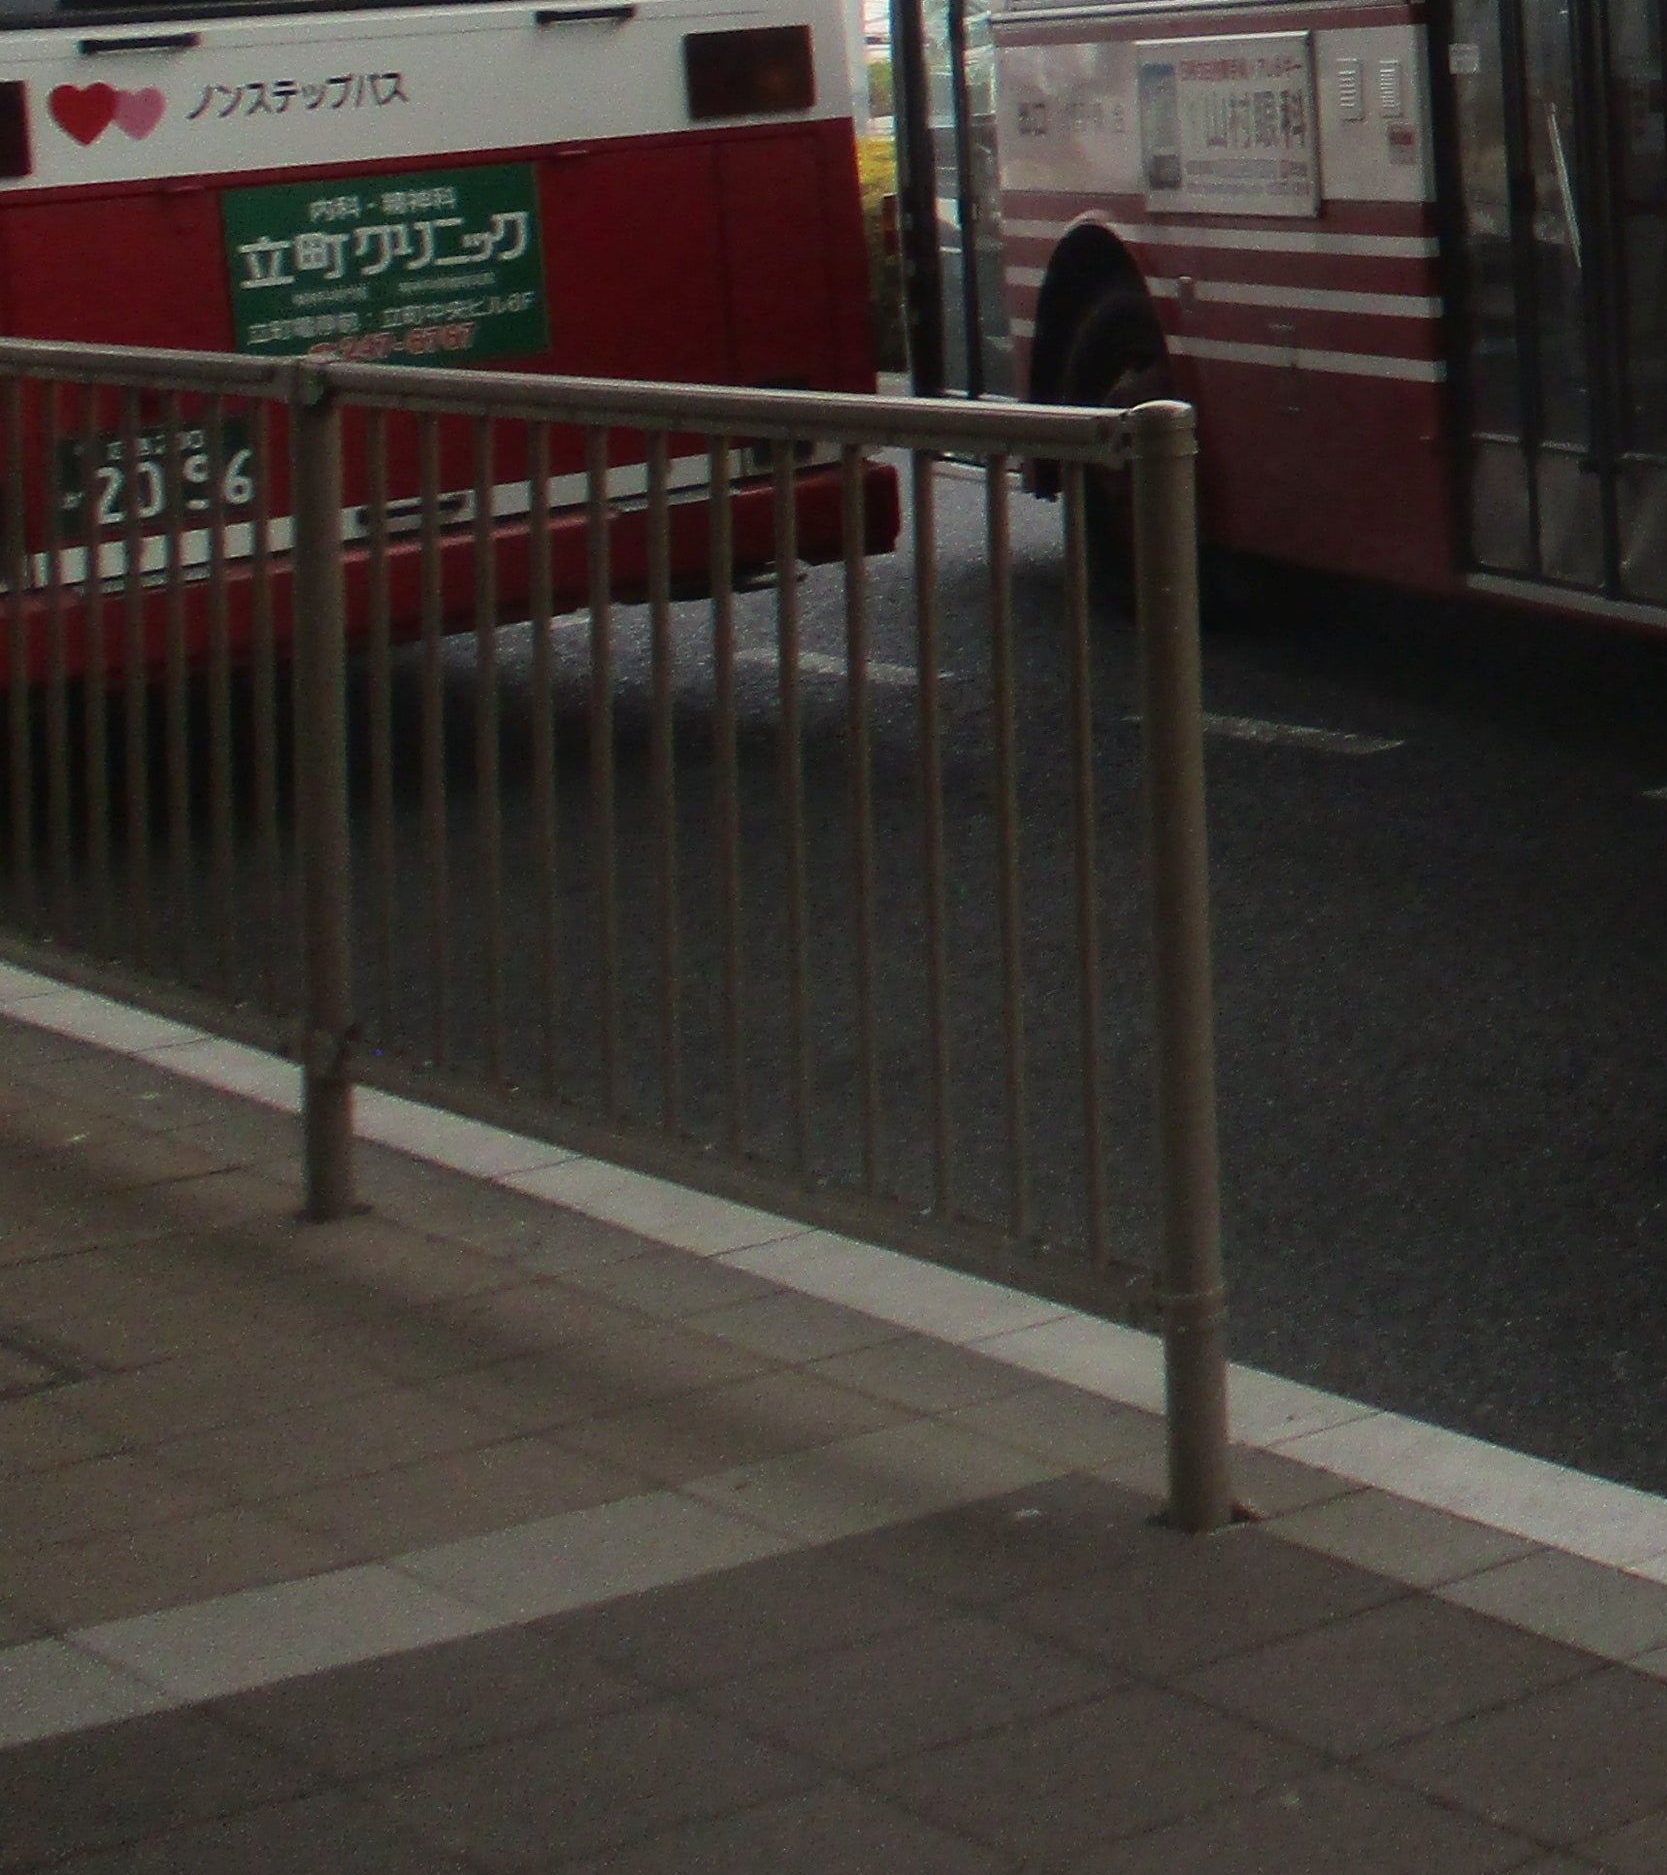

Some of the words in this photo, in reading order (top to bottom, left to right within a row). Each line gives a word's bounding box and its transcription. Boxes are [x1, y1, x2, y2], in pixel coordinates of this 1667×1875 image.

[186, 73, 409, 120] ノンステップバス
[238, 211, 529, 289] 立町クリニック
